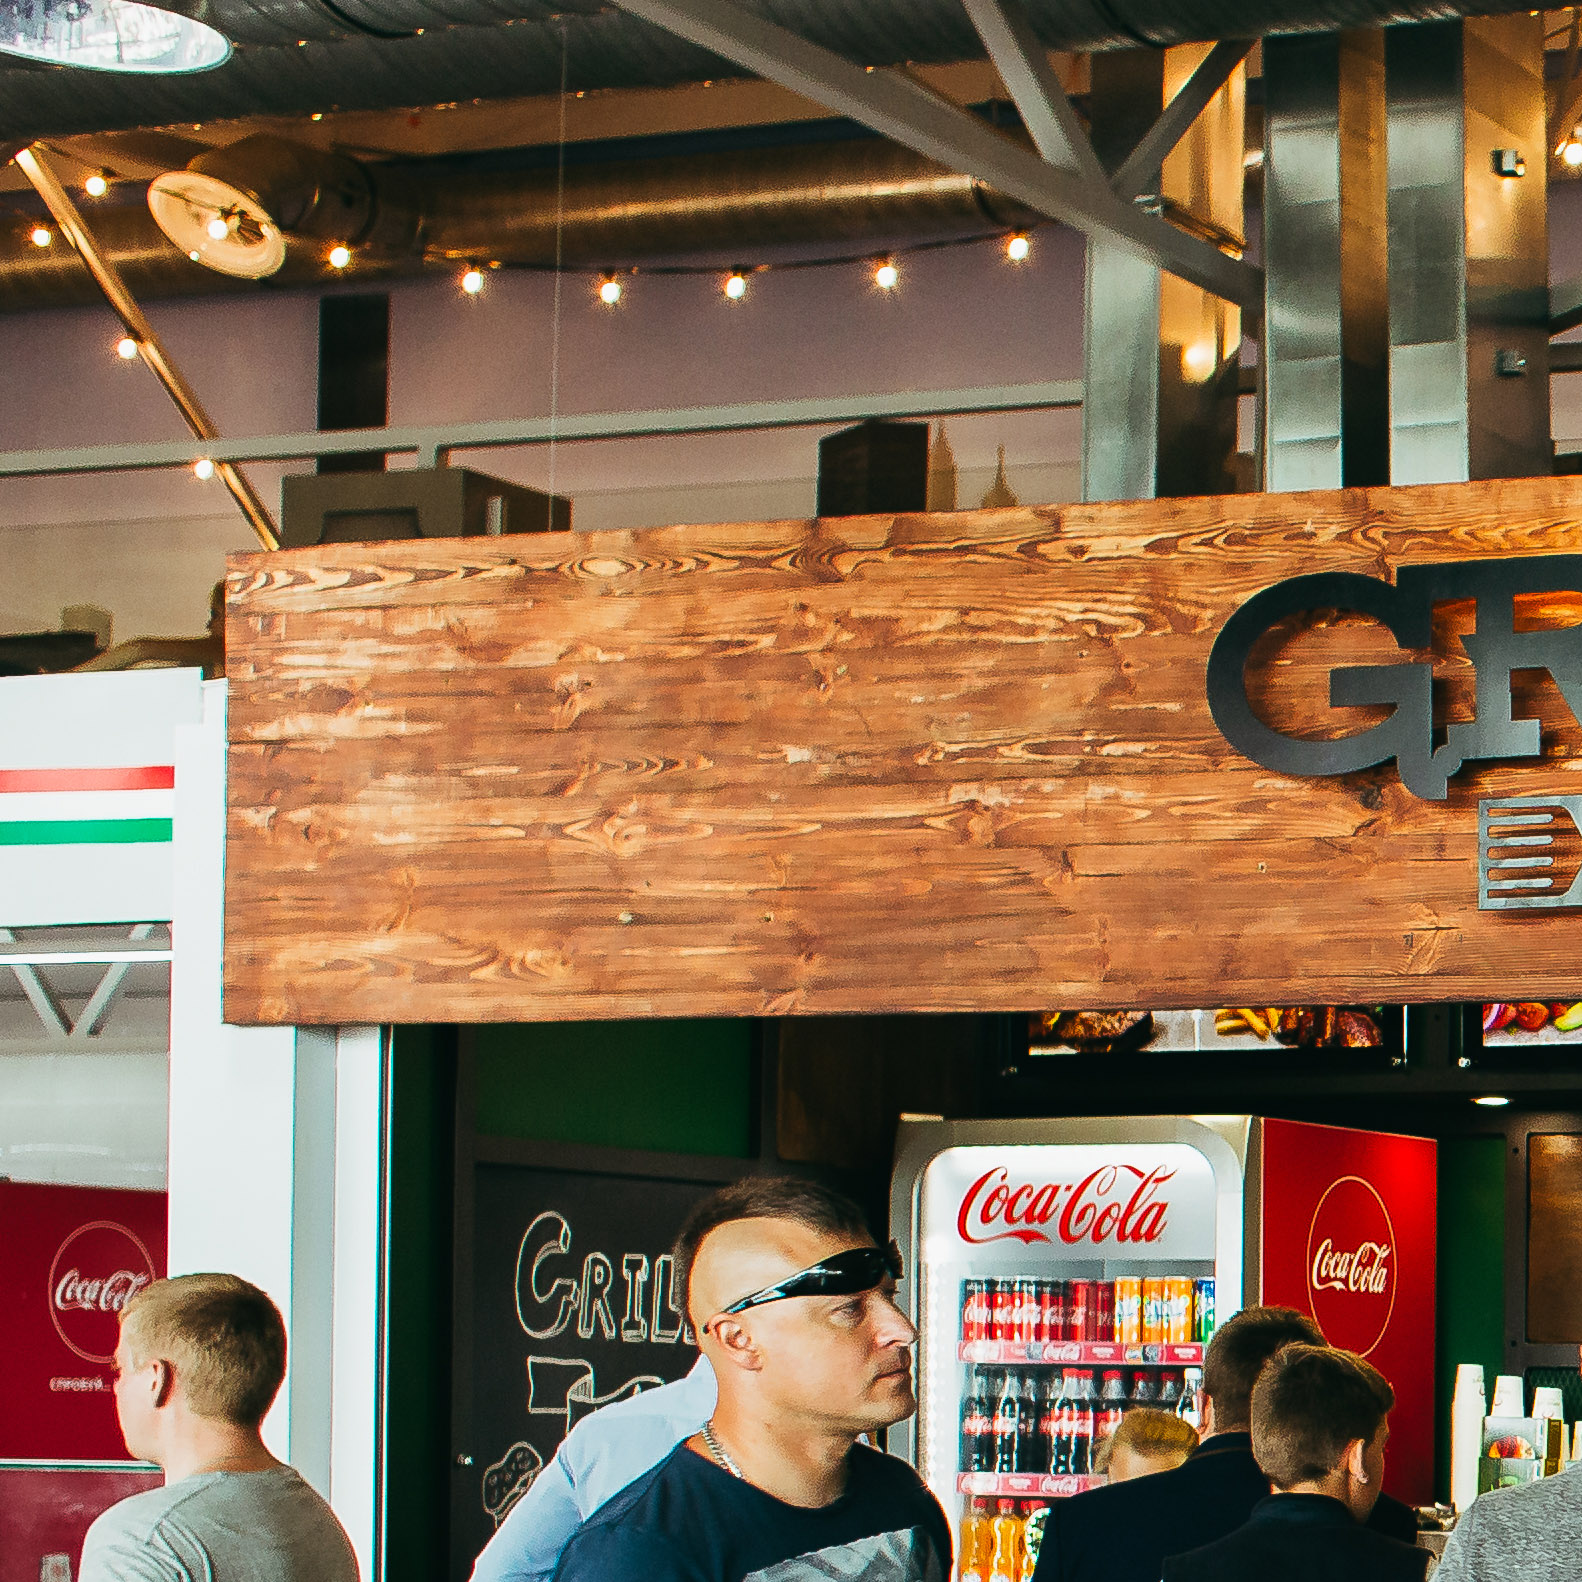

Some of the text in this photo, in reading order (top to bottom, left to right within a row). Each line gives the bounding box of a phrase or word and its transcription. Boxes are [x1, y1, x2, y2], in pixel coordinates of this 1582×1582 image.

[957, 1164, 1178, 1244] Coca-Cola
[515, 1210, 697, 1346] GRIL
[1312, 1238, 1391, 1293] Coca-Cola
